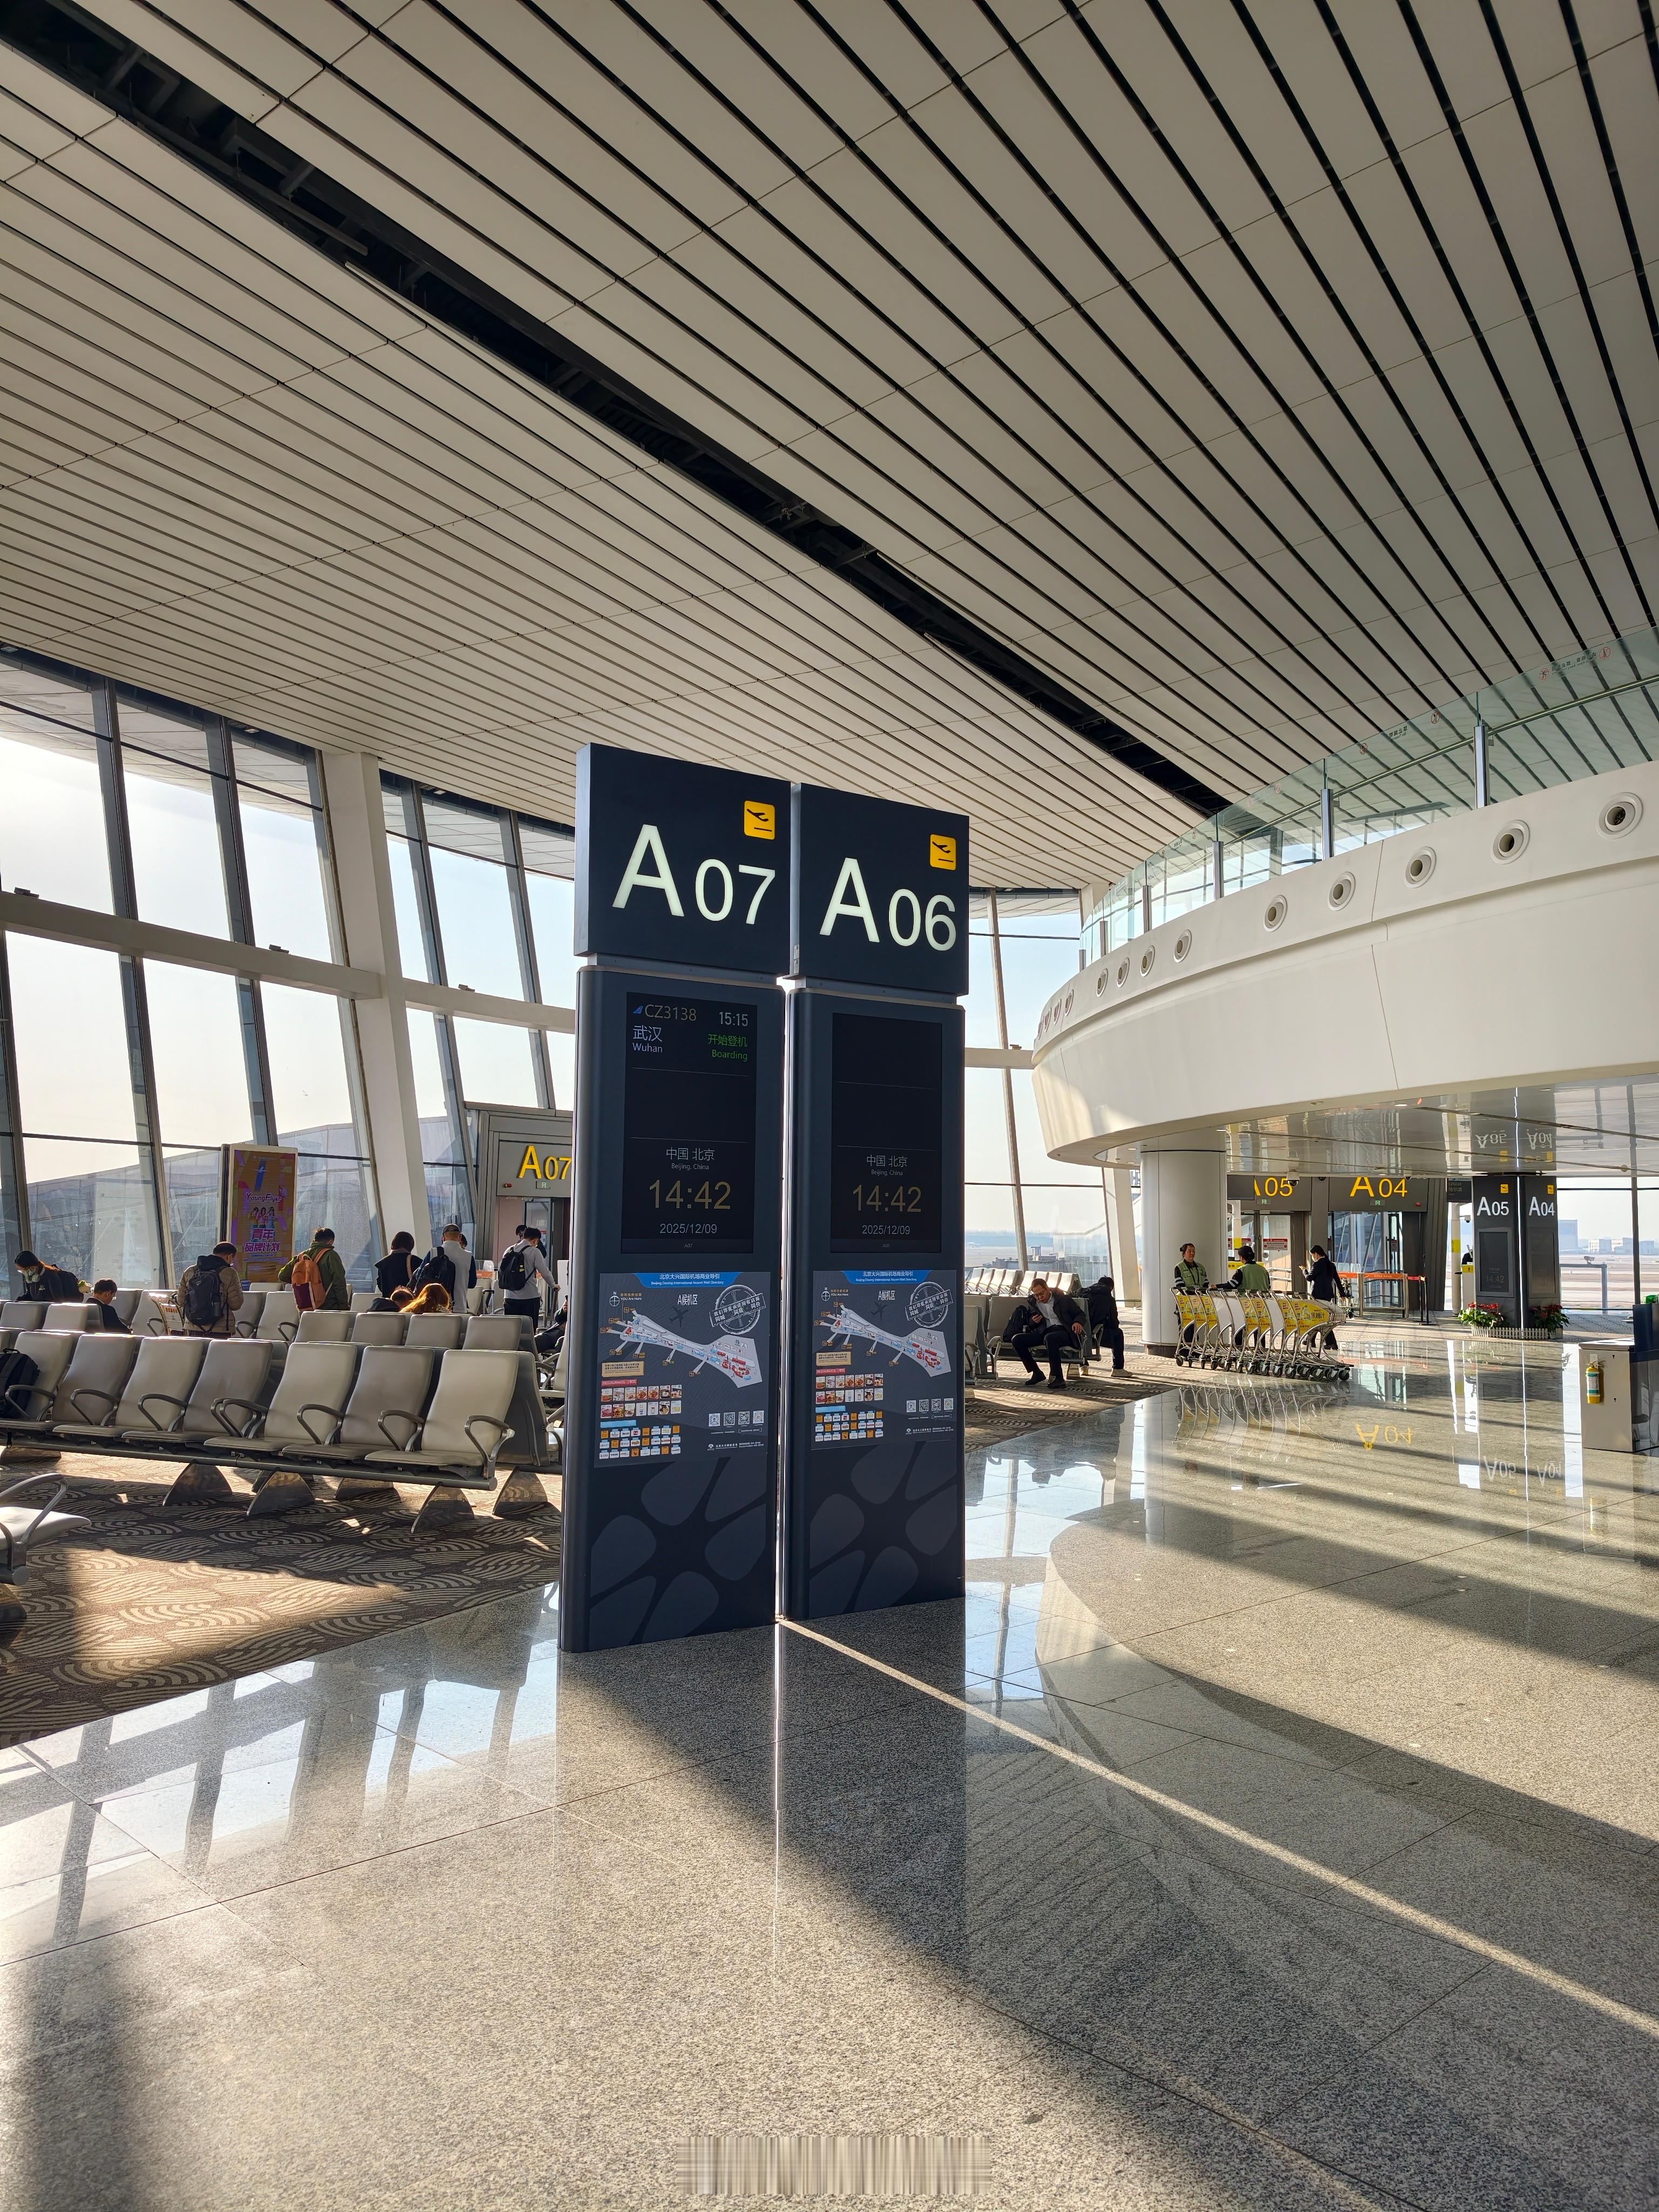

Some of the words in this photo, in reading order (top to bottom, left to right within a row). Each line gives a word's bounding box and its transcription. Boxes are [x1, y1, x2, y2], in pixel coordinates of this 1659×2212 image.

[612, 824, 775, 925] A07
[820, 858, 956, 951] A06
[645, 1004, 697, 1021] CZ3138
[719, 1011, 748, 1027] 15:15
[633, 1025, 663, 1042] 武汉
[632, 1042, 663, 1053] Wuhan
[708, 1034, 748, 1048] 开始登机
[712, 1049, 748, 1062] Boarding
[666, 1147, 689, 1160] 中国
[692, 1148, 715, 1161] 北京
[518, 1145, 572, 1180] A07
[867, 1155, 886, 1166] 中国
[888, 1155, 908, 1168] 北京
[649, 1179, 731, 1209] 14:42
[1350, 1176, 1408, 1198] A04
[246, 1192, 282, 1202] YoungFlyer
[853, 1184, 922, 1212] 14:42
[1477, 1196, 1509, 1216] A05
[1529, 1196, 1555, 1216] A04
[252, 1228, 275, 1240] 青年
[659, 1223, 717, 1234] 2025/12/09
[862, 1225, 910, 1235] 2025/12/09
[245, 1242, 280, 1253] 品牌计划
[678, 1294, 698, 1305] A候机区
[878, 1290, 895, 1300] A候机区
